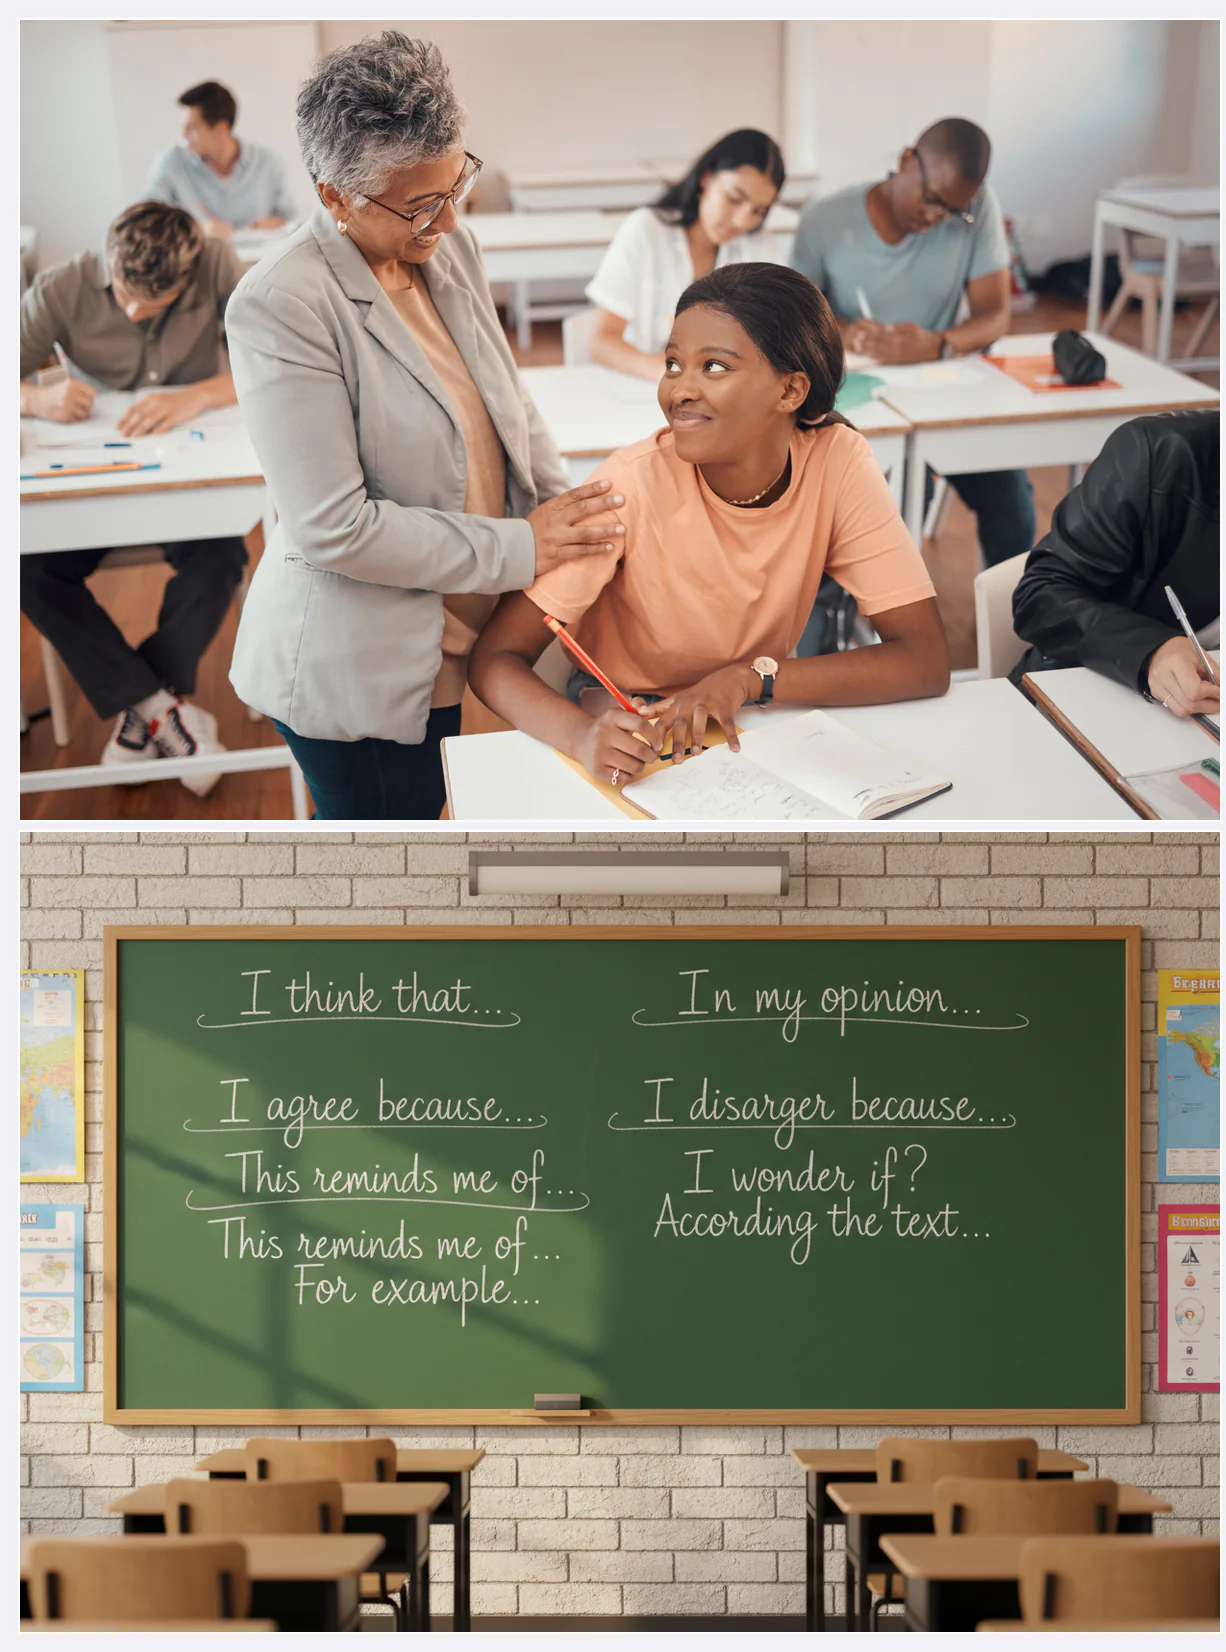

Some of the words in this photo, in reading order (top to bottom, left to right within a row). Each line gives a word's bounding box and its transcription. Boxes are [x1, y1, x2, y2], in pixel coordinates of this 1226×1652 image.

[241, 970, 271, 1015] I
[285, 971, 382, 1014] think
[392, 971, 501, 1014] that...
[679, 969, 736, 1015] In
[756, 988, 806, 1043] my
[821, 980, 981, 1037] opinion...
[220, 1078, 249, 1123] I
[267, 1094, 359, 1148] agree
[379, 1078, 533, 1122] because...
[644, 1078, 674, 1123] I
[689, 1077, 835, 1150] disarger
[851, 1077, 1007, 1122] because...
[225, 1150, 300, 1194] This
[314, 1153, 438, 1194] reminds
[453, 1168, 498, 1194] me
[684, 1149, 714, 1194] I
[732, 1150, 854, 1193] wonder
[871, 1144, 927, 1209] if?
[207, 1216, 284, 1259] This
[298, 1219, 424, 1260] reminds
[437, 1234, 482, 1260] me
[654, 1192, 818, 1265] According
[827, 1196, 883, 1237] the
[891, 1203, 990, 1240] text...
[294, 1263, 357, 1305] For
[371, 1265, 539, 1327] example...
